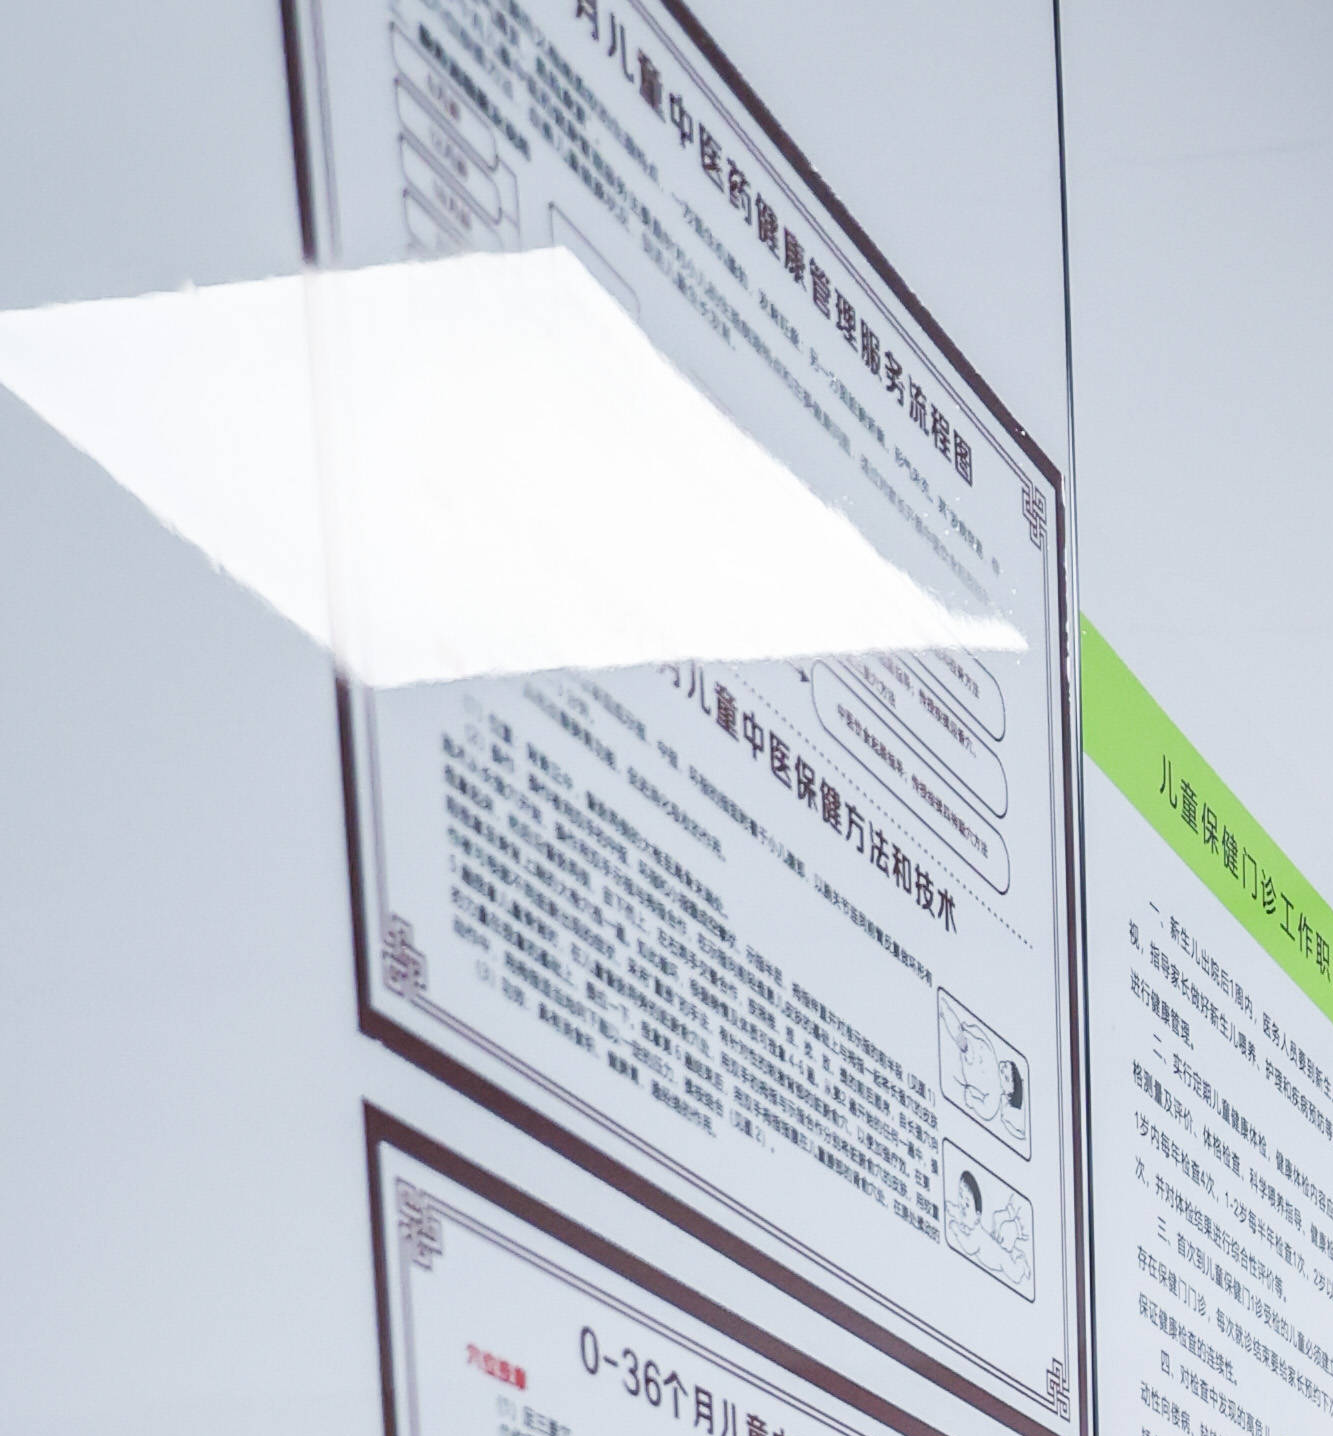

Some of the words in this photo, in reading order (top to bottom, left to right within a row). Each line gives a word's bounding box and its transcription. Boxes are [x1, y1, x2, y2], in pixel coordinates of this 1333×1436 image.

[1129, 965, 1194, 1054] 进行健康管理。
[1138, 1288, 1238, 1389] 保证健康检查的连续性。
